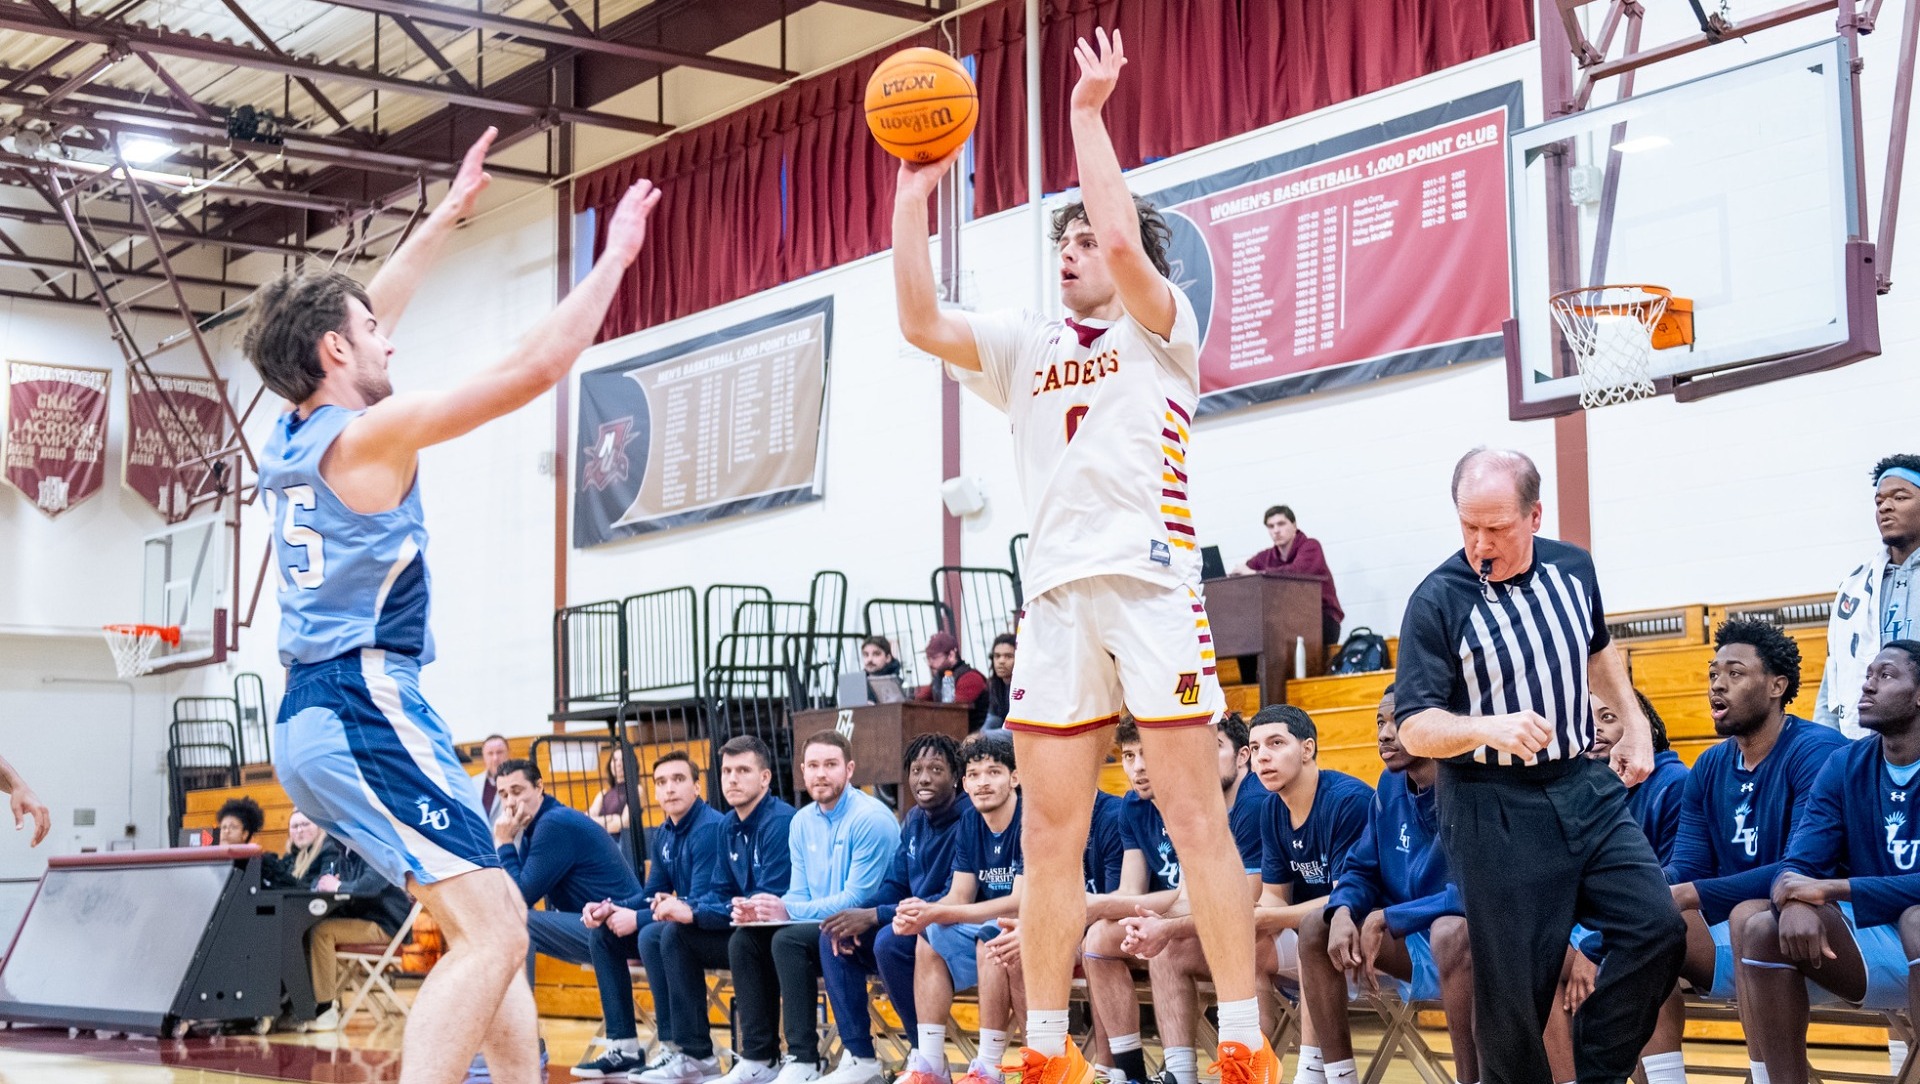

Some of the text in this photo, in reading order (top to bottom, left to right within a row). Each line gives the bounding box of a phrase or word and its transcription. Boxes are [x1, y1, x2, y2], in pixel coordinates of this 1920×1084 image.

[882, 74, 937, 98] NCAA
[879, 107, 955, 133] Wilson
[1210, 124, 1498, 220] WOMEN'S BASKETBALL 1,000 POINT CLUB
[683, 352, 734, 377] BASKETBALL
[759, 335, 786, 353] POINT
[787, 328, 811, 346] CLUB
[1032, 348, 1120, 397] CADETS
[37, 393, 79, 411] GNAC
[14, 418, 100, 436] LACROSSE
[9, 431, 103, 451] CHAMPIONS
